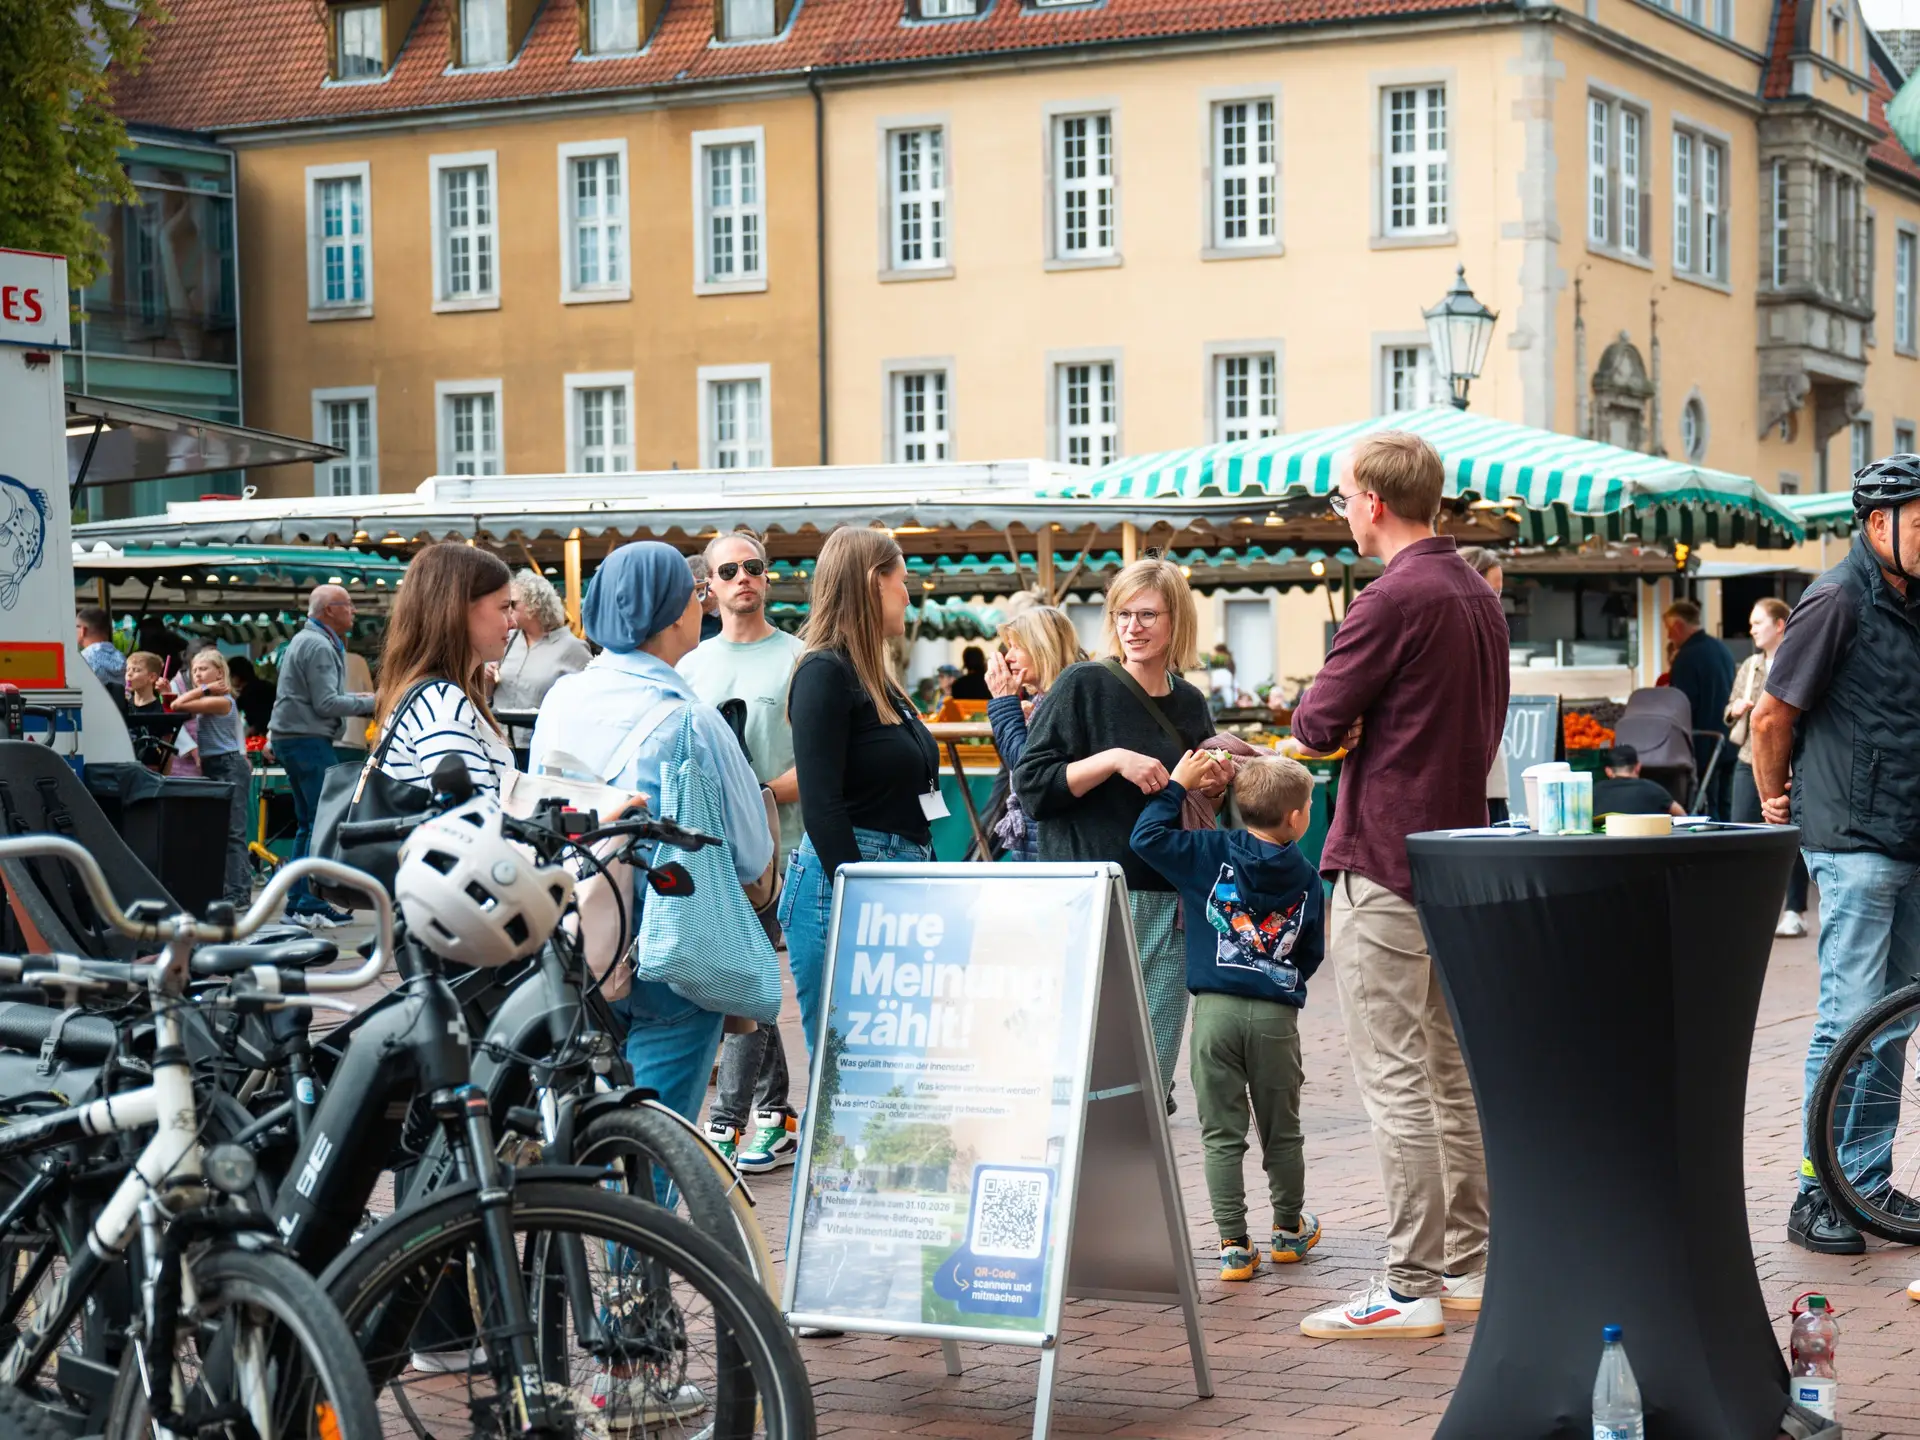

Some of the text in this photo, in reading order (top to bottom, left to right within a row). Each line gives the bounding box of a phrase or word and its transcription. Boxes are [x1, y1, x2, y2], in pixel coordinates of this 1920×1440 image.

[856, 902, 945, 947] Ihre
[850, 950, 1051, 1008] Meinung
[845, 999, 975, 1048] zählt!
[840, 1058, 975, 1072] Was gefällt Ihnen an der Innenstadt?
[917, 1082, 934, 1091] Was
[1006, 1086, 1041, 1096] werden?
[834, 1099, 851, 1108] Was
[852, 1099, 869, 1108] sind
[870, 1100, 898, 1111] Gründe,
[965, 1104, 1004, 1114] besuchen
[889, 1110, 906, 1118] oder
[825, 1195, 857, 1205] Nehmen
[863, 1212, 934, 1226] Online-Befragung
[855, 1225, 914, 1239] Innenstädte
[974, 1266, 1016, 1279] QR-Code
[972, 1280, 1032, 1292] scannen und
[971, 1290, 1023, 1303] mitmachen
